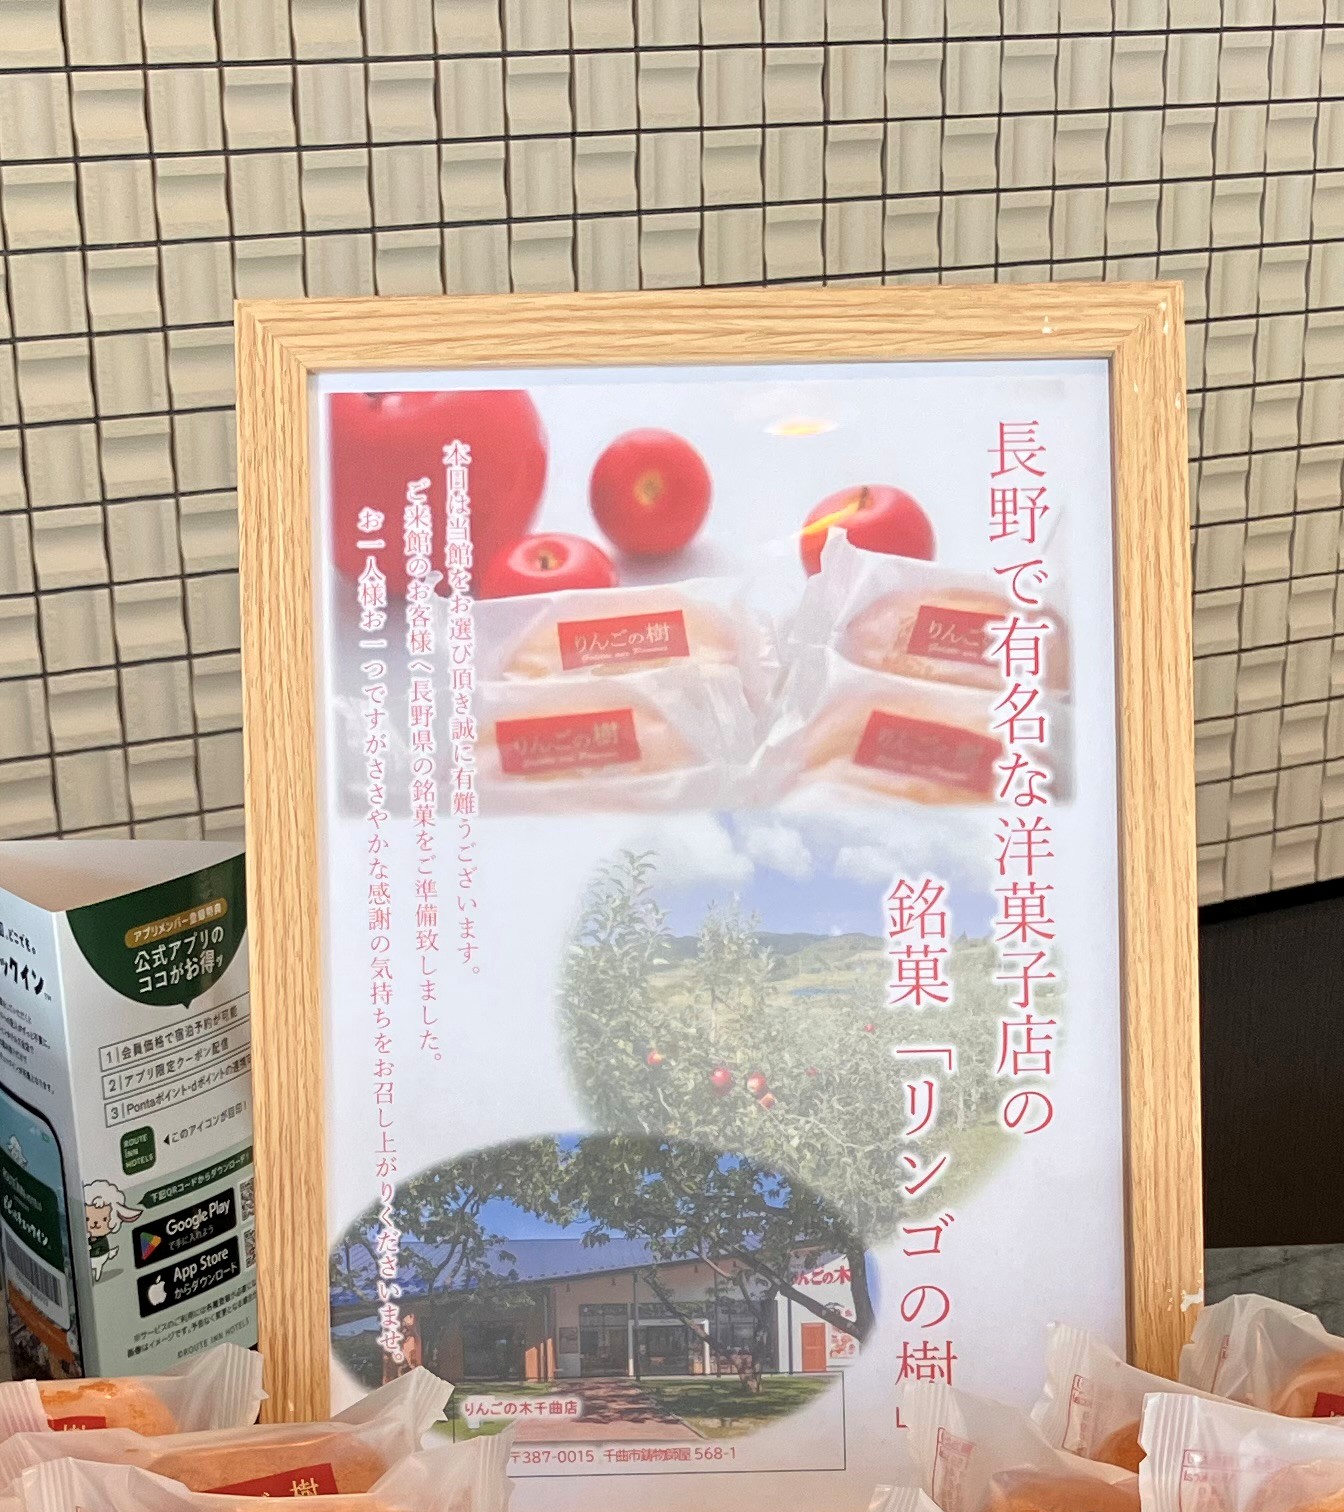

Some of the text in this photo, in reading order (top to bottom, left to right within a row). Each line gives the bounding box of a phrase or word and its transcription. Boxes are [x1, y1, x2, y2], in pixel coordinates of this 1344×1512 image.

[445, 442, 480, 975] 本日は当館をお選び頂き誠に有難うございます。
[406, 478, 442, 1061] ご来館のお客様へ長野県の銘菓をご準備致しました。
[987, 420, 1056, 1134] 長野で有名な洋菓子店の
[134, 926, 224, 973] 公式アプリの
[358, 510, 403, 1362] お一人様お一つですがささやかな感謝の気持ちをお召し上がりくださいませ。
[106, 1005, 238, 1064] 1 会員価格で宿泊予約が可能
[108, 1037, 229, 1092] 2 アプリ限定クーポン配信
[110, 1107, 119, 1120] 3
[165, 1198, 231, 1236] Google Play
[173, 1248, 229, 1283] App Store
[174, 1262, 239, 1300] からダウンロード
[464, 1400, 578, 1416] りんごの木千曲店
[510, 1449, 595, 1464] 〒387-0015
